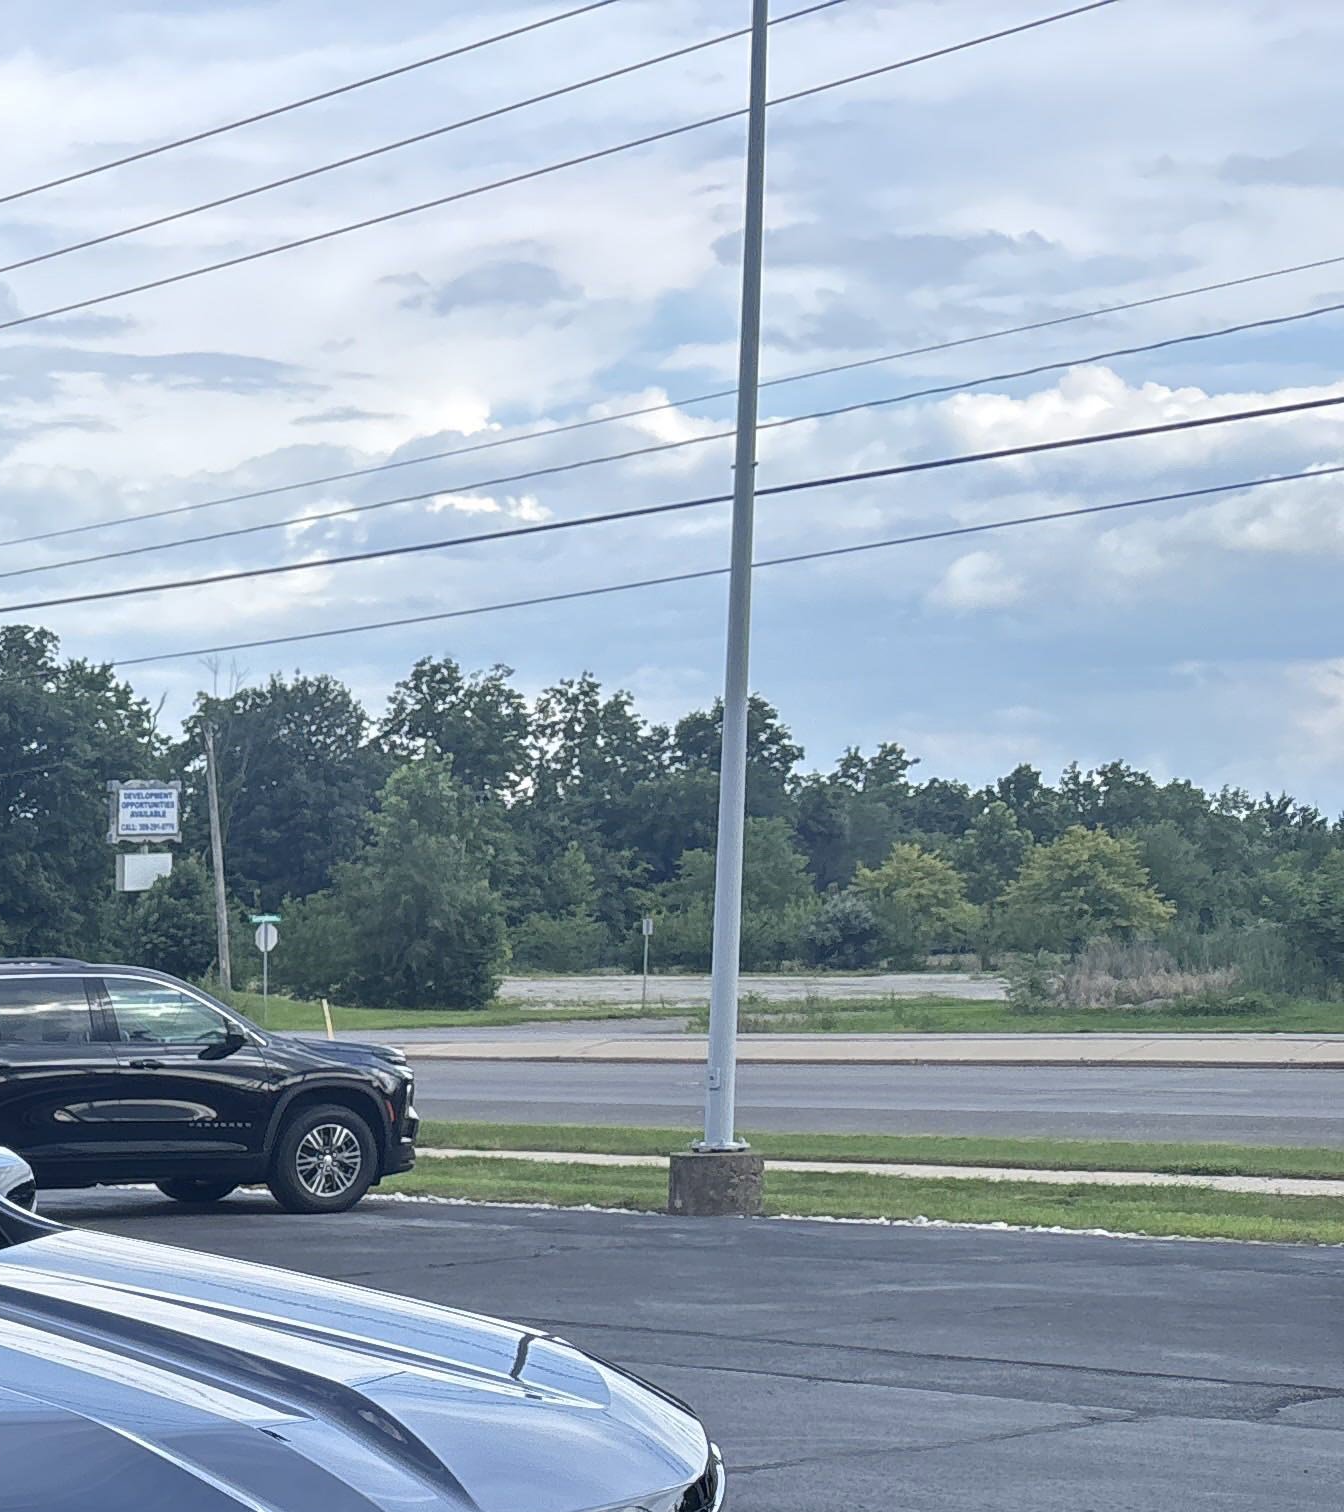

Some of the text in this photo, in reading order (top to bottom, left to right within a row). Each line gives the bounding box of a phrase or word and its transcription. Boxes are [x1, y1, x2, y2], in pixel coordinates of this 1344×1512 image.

[123, 792, 172, 800] DEVELOPMENT
[121, 801, 174, 809] OPPORTUNITIES
[130, 810, 166, 818] AVAILABLE
